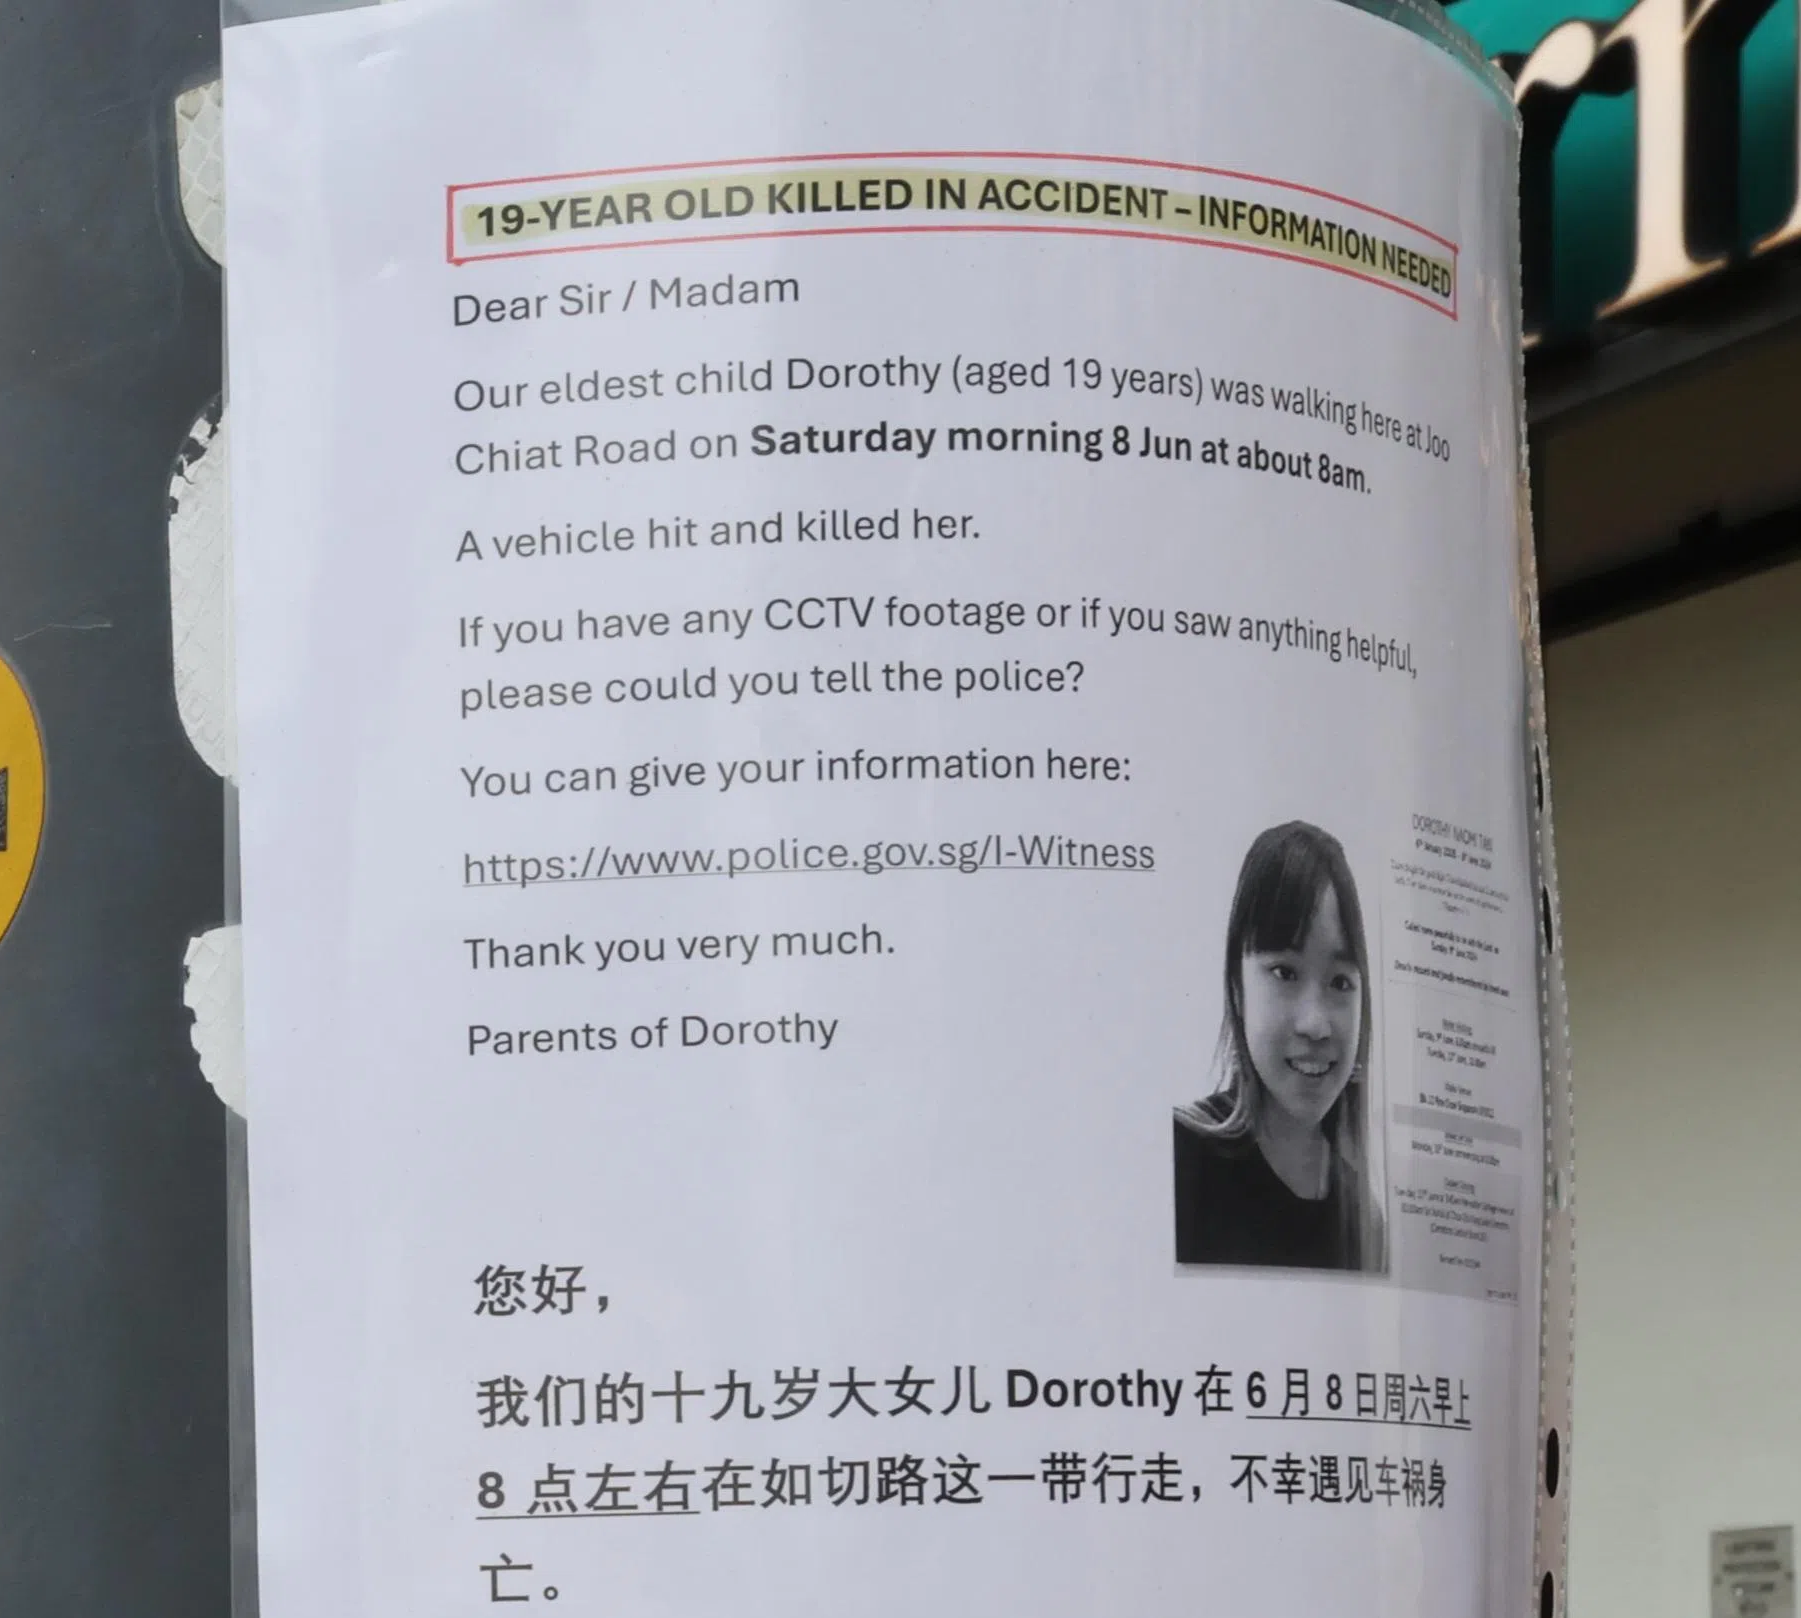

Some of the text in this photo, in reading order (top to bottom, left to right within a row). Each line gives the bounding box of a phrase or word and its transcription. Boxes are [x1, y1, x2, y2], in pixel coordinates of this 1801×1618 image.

[476, 191, 654, 238] 19-YEAR
[663, 185, 755, 222] OLD
[767, 177, 915, 216] KILLED
[924, 177, 967, 211] IN
[976, 177, 1169, 221] ACCIDENT
[1198, 194, 1377, 268] INFORMATION
[1381, 240, 1452, 299] NEEDED
[453, 273, 800, 328] Dear Sir / Madam
[453, 353, 1451, 463] Our eldest child Dorothy (aged 19 years) was walking here at Joo
[455, 420, 1372, 495] Chiat Road on Saturday morning 8 Jun at about 8am.
[455, 507, 980, 563] A vehicle hit and killed her.
[459, 595, 1417, 680] If you have any CCTV footage or if you saw anything helpful,
[461, 659, 1085, 720] please could you tell the police?
[459, 746, 1131, 799] You can give your information here:
[464, 834, 1155, 889] https://www.police.gov.sg/I-Witness
[462, 922, 895, 972] Thank you very much.
[468, 1011, 839, 1057] Parents of Dorothy
[1006, 1367, 1184, 1418] Dorothy
